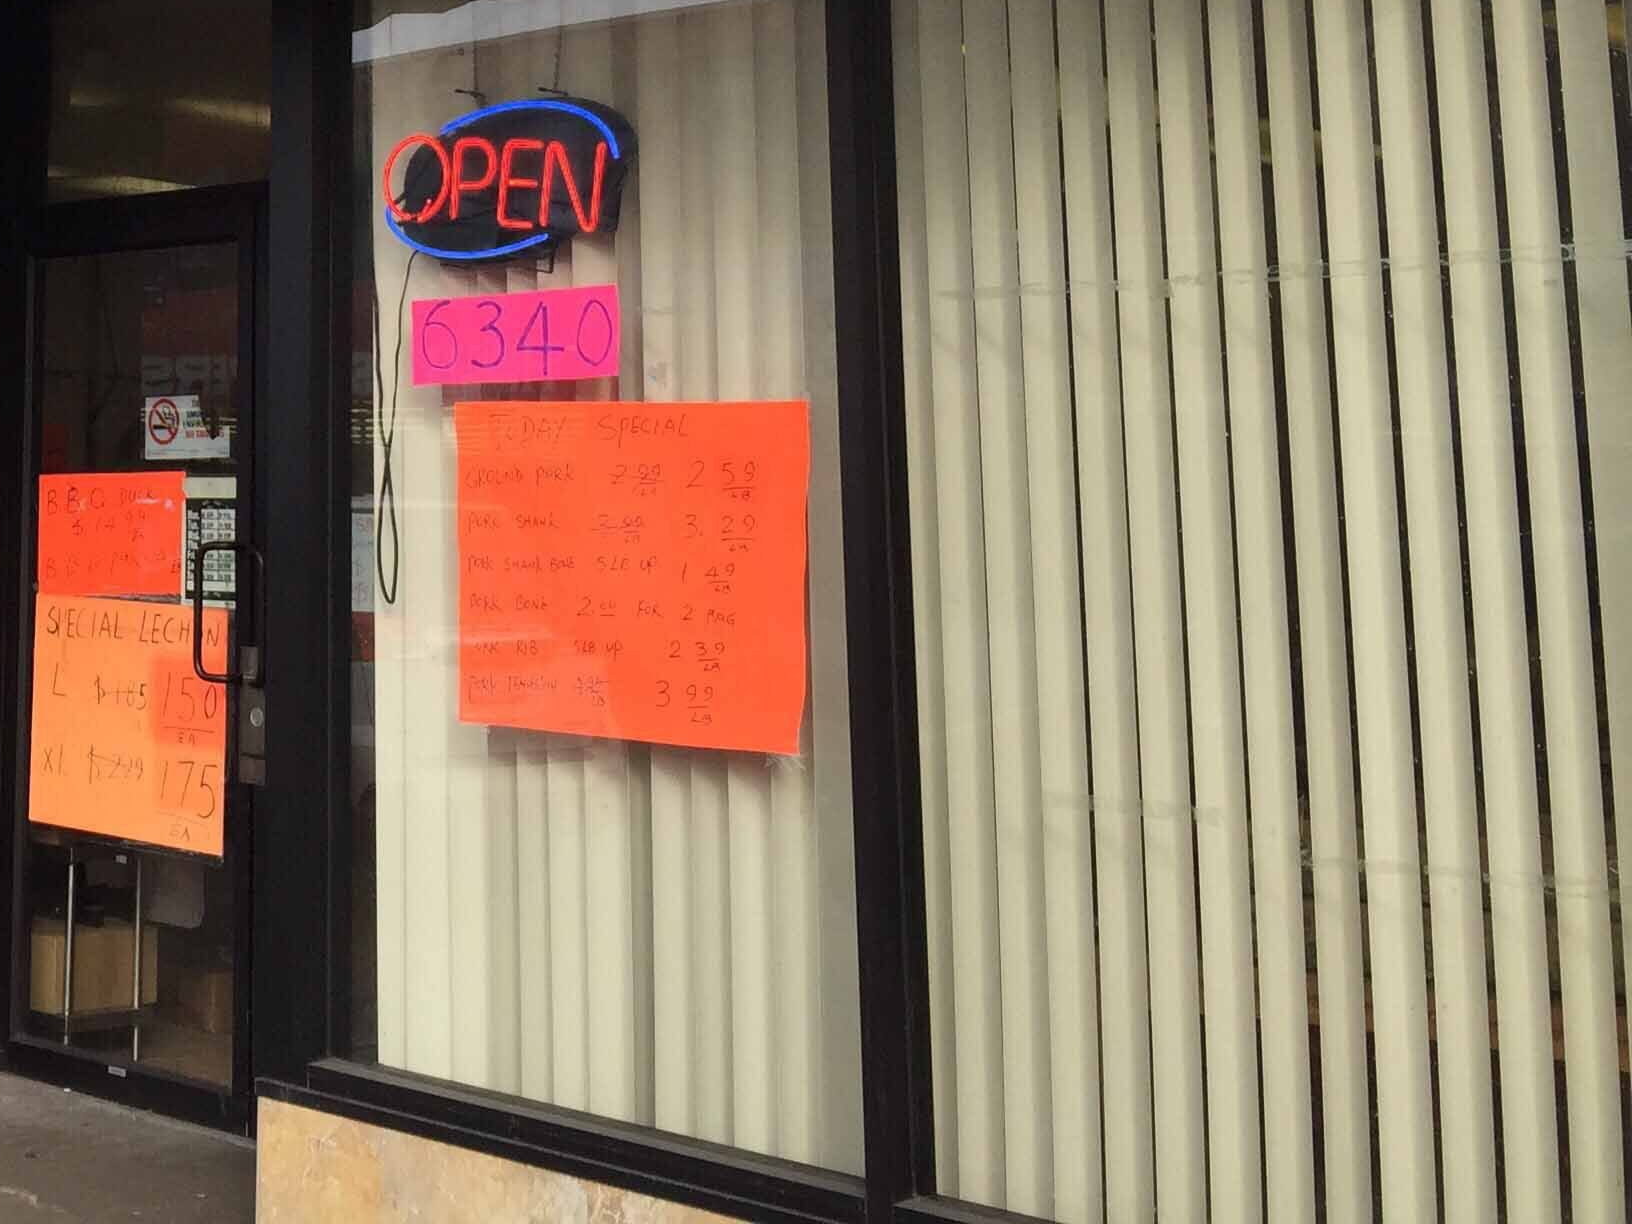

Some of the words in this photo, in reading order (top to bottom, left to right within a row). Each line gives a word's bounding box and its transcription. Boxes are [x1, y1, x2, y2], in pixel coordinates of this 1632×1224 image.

[384, 134, 607, 234] OPEN
[421, 298, 613, 376] 6340
[598, 413, 689, 449] SPECIAL
[138, 609, 220, 648] LECHN
[51, 662, 67, 697] L
[163, 672, 218, 722] 150
[160, 760, 218, 819] 175
